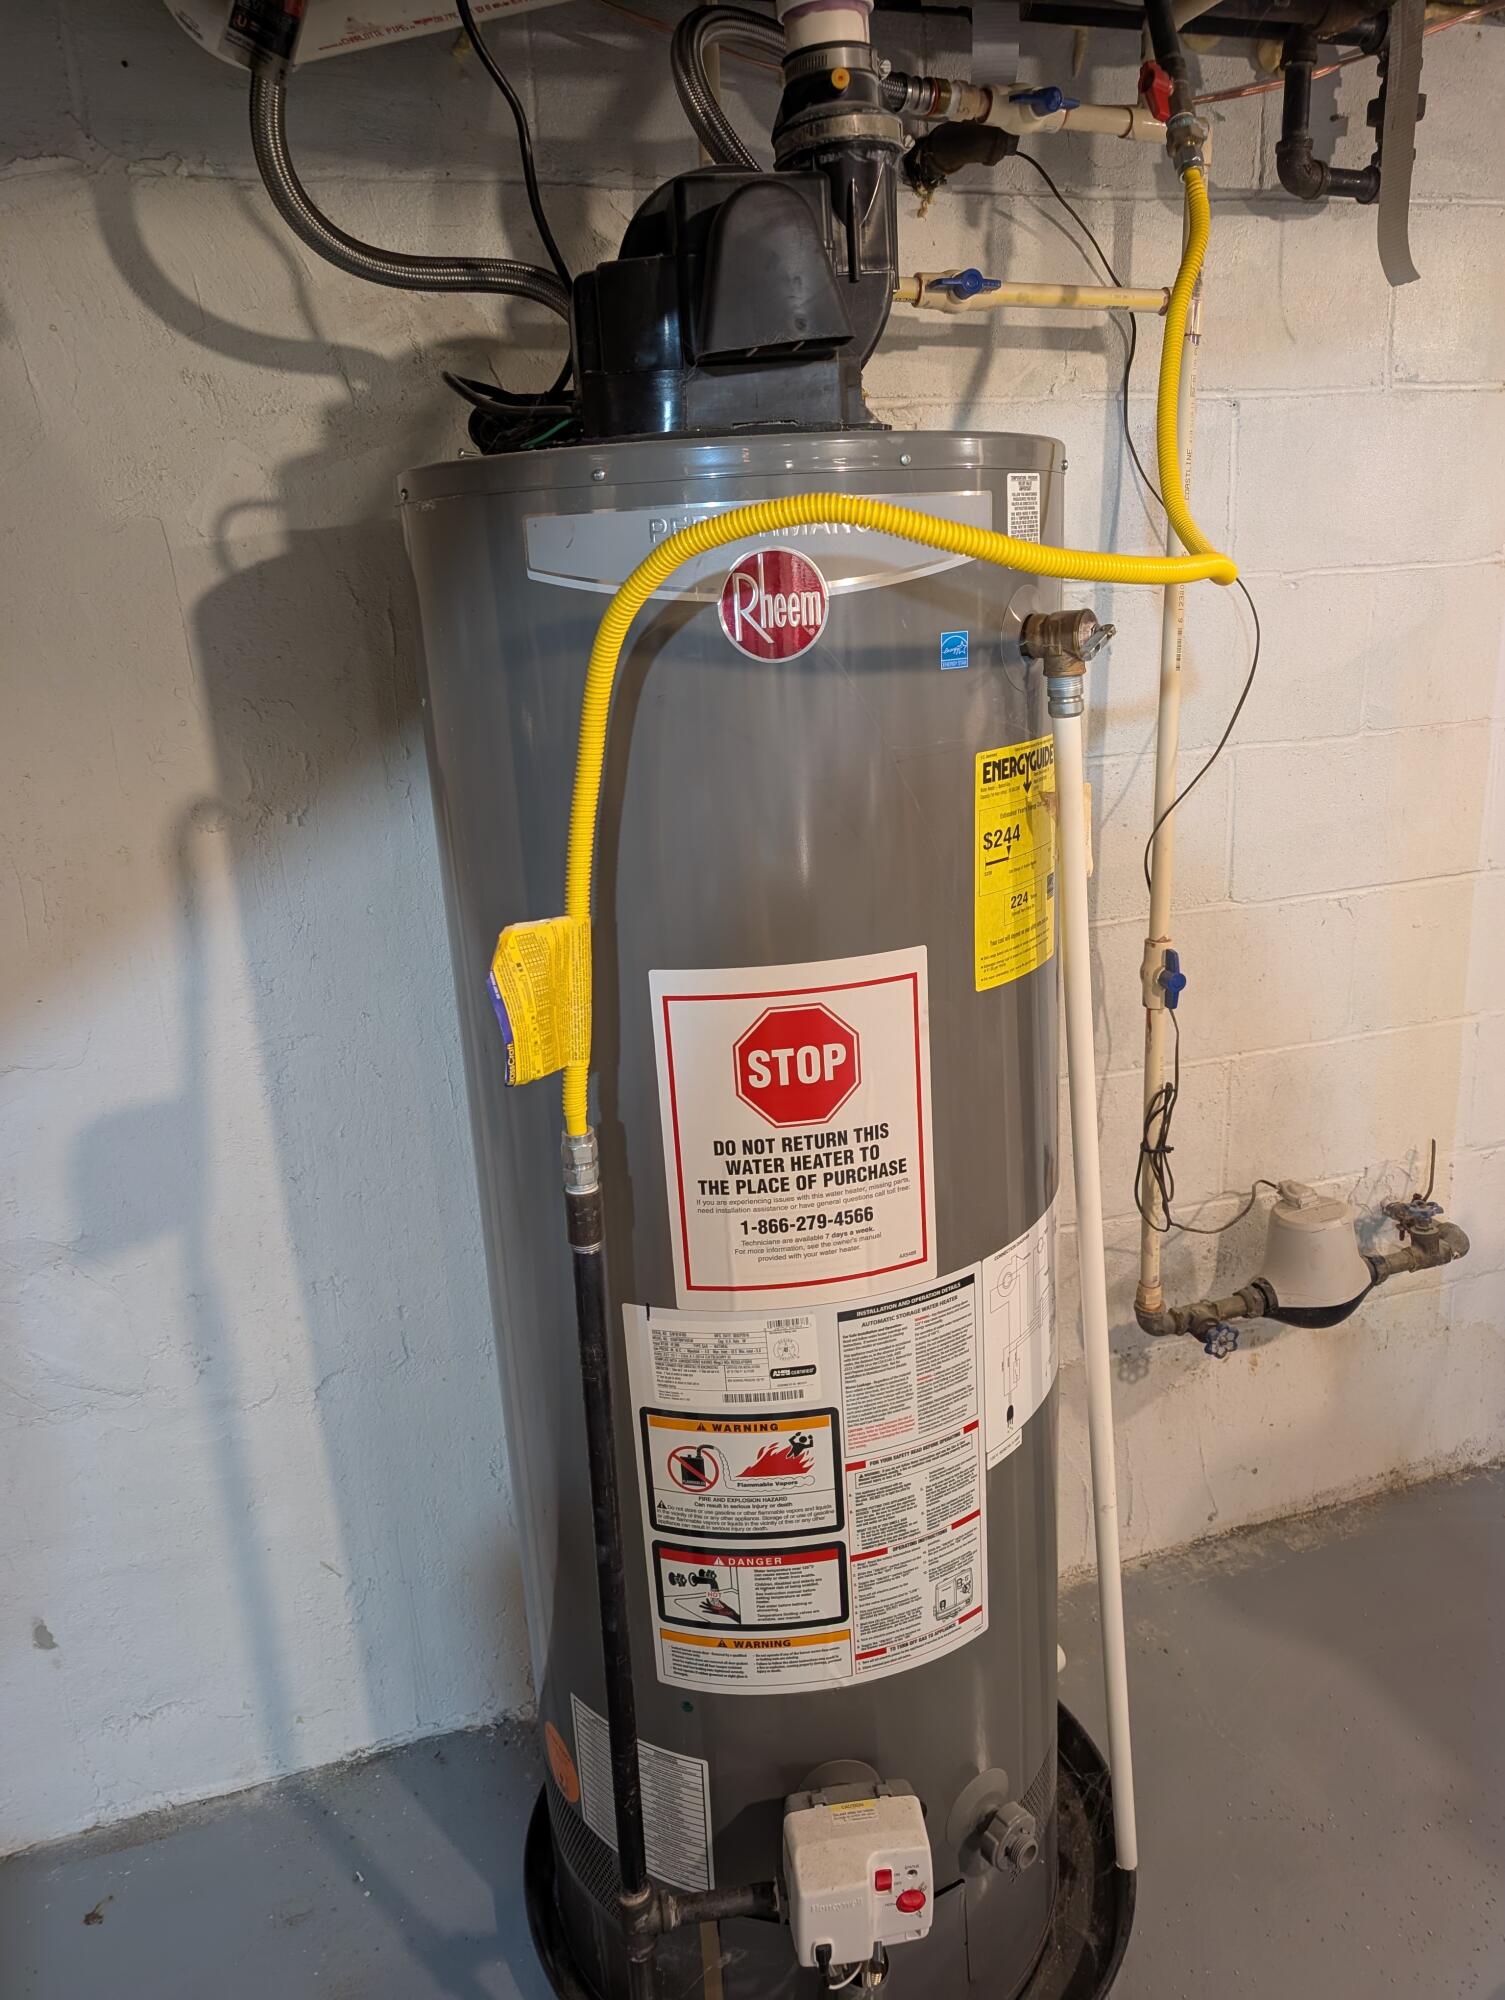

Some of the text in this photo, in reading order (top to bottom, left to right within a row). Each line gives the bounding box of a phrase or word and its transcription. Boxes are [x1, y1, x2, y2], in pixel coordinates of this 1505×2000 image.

[733, 554, 822, 643] Rheem
[1011, 891, 1028, 909] 224
[748, 1043, 847, 1088] STOP
[714, 1123, 889, 1156] DO NOT RETURN THIS
[726, 1145, 880, 1175] WATER HEATER TO
[698, 1158, 907, 1195] THE PLACE OF PURCHASE
[729, 1198, 771, 1206] experiencing
[869, 1182, 892, 1191] missing
[753, 1204, 788, 1212] assistance
[816, 1199, 841, 1208] general
[843, 1194, 873, 1204] questions
[875, 1191, 885, 1199] call
[740, 1206, 873, 1235] 1-866-279-4566
[766, 1245, 805, 1254] information,
[833, 1237, 857, 1246] owner's
[859, 1232, 882, 1241] manual
[795, 1235, 823, 1243] available
[832, 1231, 848, 1240] days
[758, 1254, 786, 1262] provided
[788, 1252, 801, 1260] with
[839, 1245, 860, 1254] heater.
[857, 1302, 897, 1316] INSTALLATION
[911, 1290, 940, 1304] OPERATION
[942, 1283, 960, 1293] DETAILS
[862, 1295, 958, 1327] AUTOMATIC STORAGE WATER HEATER
[712, 1423, 779, 1432] WARNING
[893, 1452, 909, 1461] SAFETY
[923, 1442, 939, 1450] BEFORE
[939, 1432, 960, 1443] OPERATING
[728, 1557, 781, 1566] DANGER
[733, 1639, 791, 1649] WARNING
